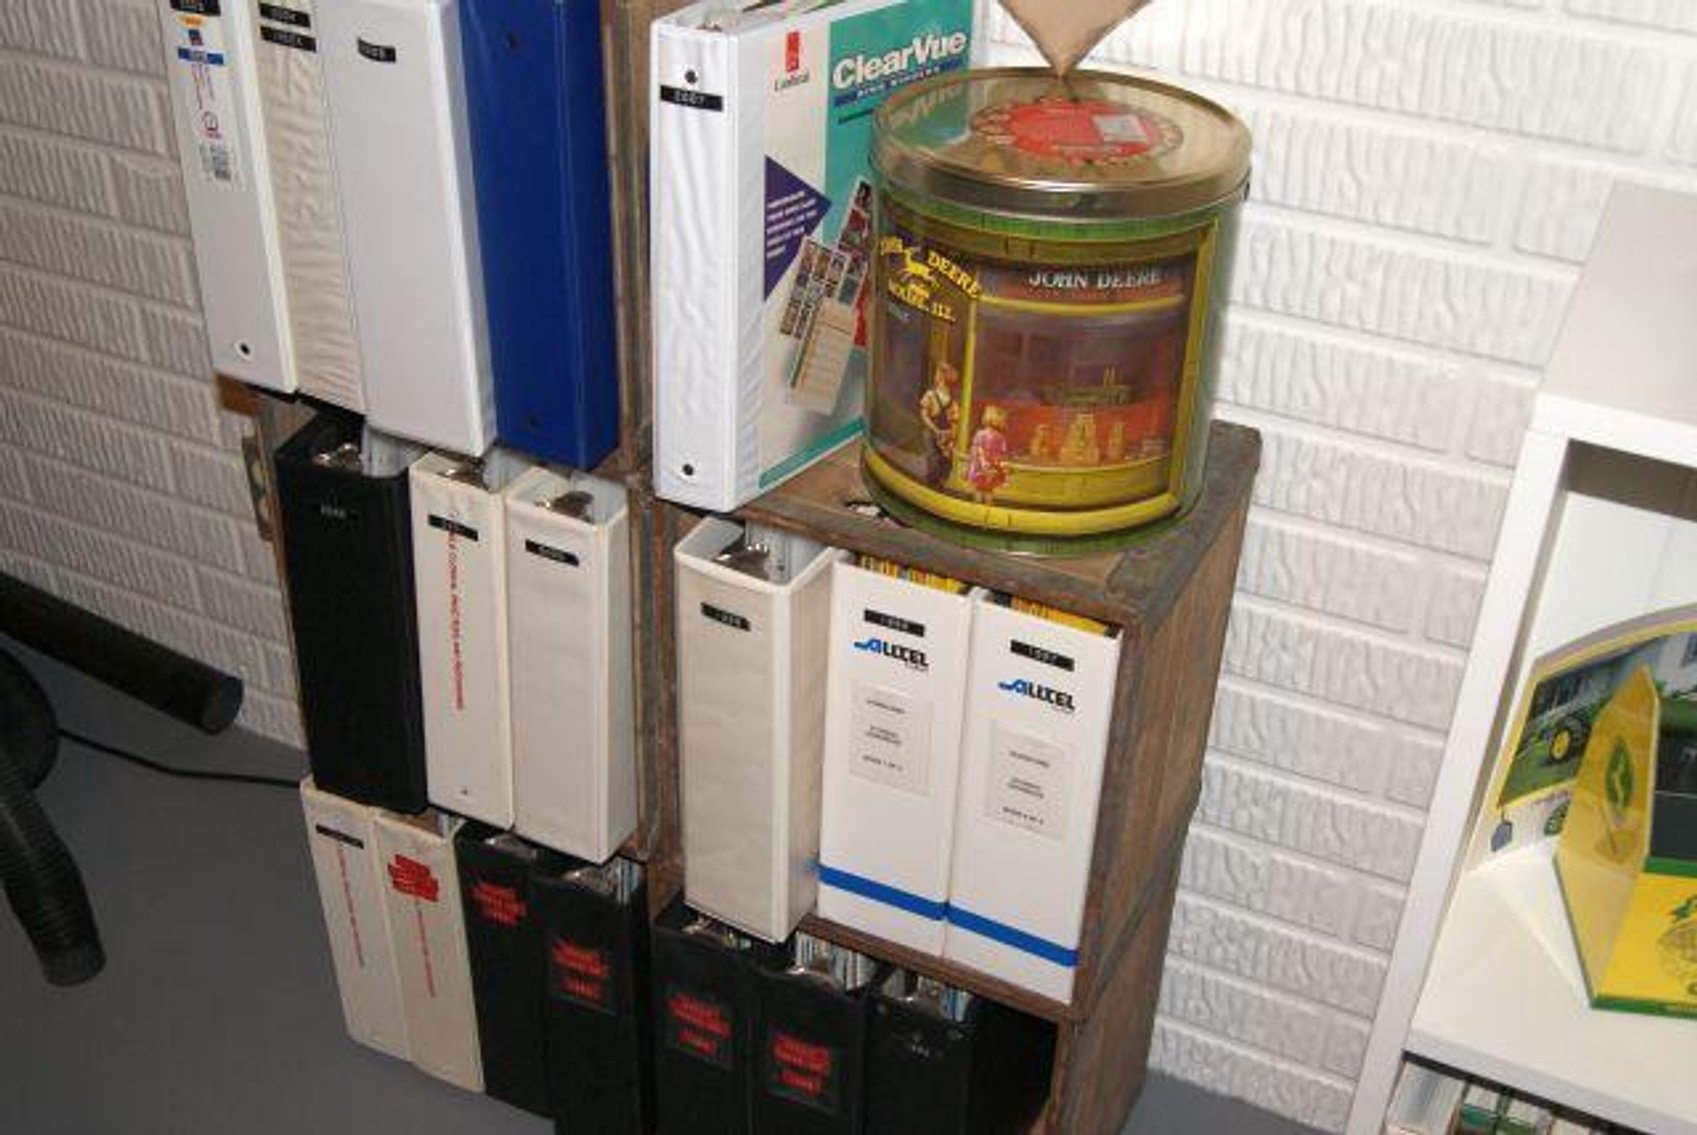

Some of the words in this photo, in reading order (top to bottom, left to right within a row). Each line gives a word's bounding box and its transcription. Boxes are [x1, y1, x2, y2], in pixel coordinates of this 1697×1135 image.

[832, 31, 967, 89] ClearVue
[927, 250, 979, 299] DEERE
[1028, 272, 1088, 288] JOHN
[1097, 269, 1162, 288] DEERE
